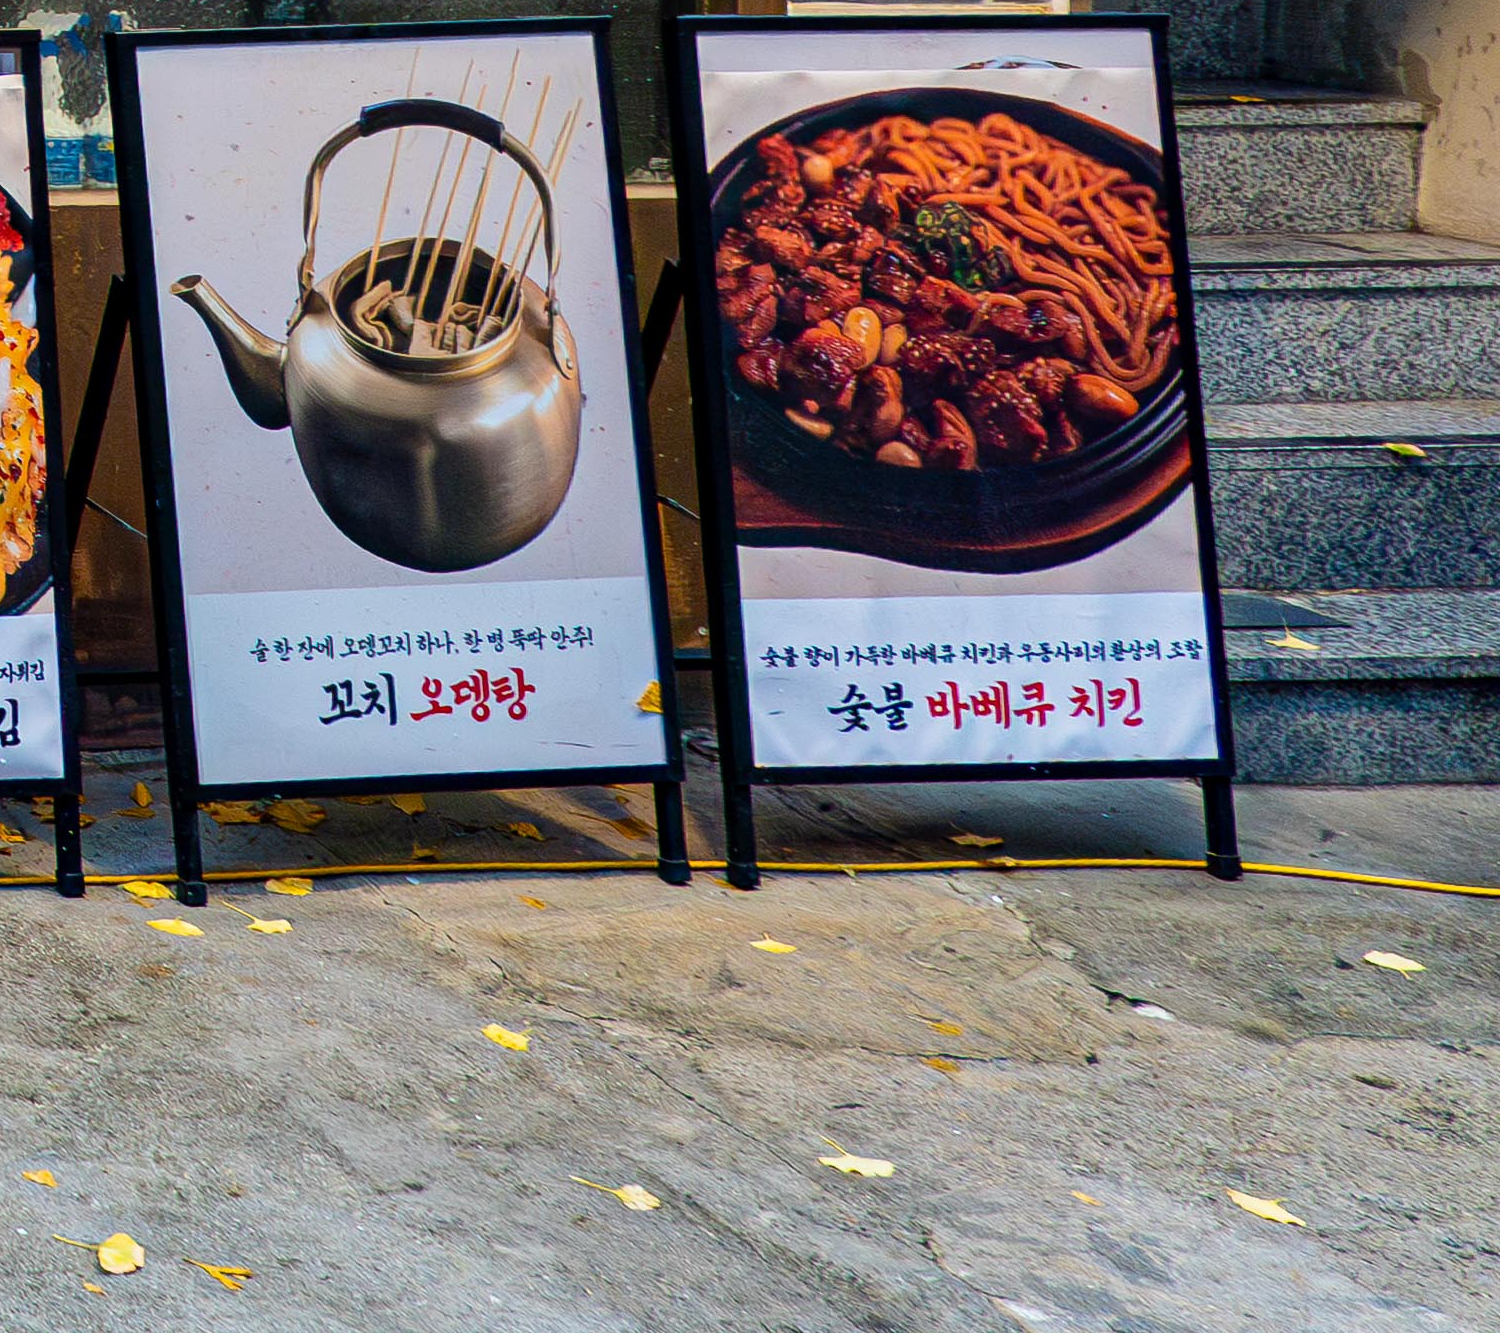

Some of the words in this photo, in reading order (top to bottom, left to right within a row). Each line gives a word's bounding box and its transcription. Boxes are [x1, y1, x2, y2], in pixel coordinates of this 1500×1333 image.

[250, 641, 269, 663] 술
[272, 639, 293, 661] 한
[298, 637, 334, 661] 잔에
[338, 633, 412, 658] 오뎅꼬치
[461, 631, 483, 653] 한
[487, 631, 504, 652] 병
[509, 629, 546, 652] 뚝딱
[550, 625, 593, 649] 안주!
[761, 646, 799, 667] 숯불
[804, 646, 840, 667] 향이
[845, 645, 898, 666] 가득한
[902, 644, 957, 665] 바베큐
[962, 643, 1012, 665] 치킨과
[1017, 642, 1105, 664] 우동사리의
[1110, 639, 1161, 662] 환상의
[1168, 639, 1203, 661] 조합
[318, 673, 397, 725] 꼬치
[411, 667, 535, 722] 오뎅탕
[828, 682, 913, 732] 숯불
[926, 680, 1055, 728] 바베큐
[1070, 678, 1143, 728] 치킨
